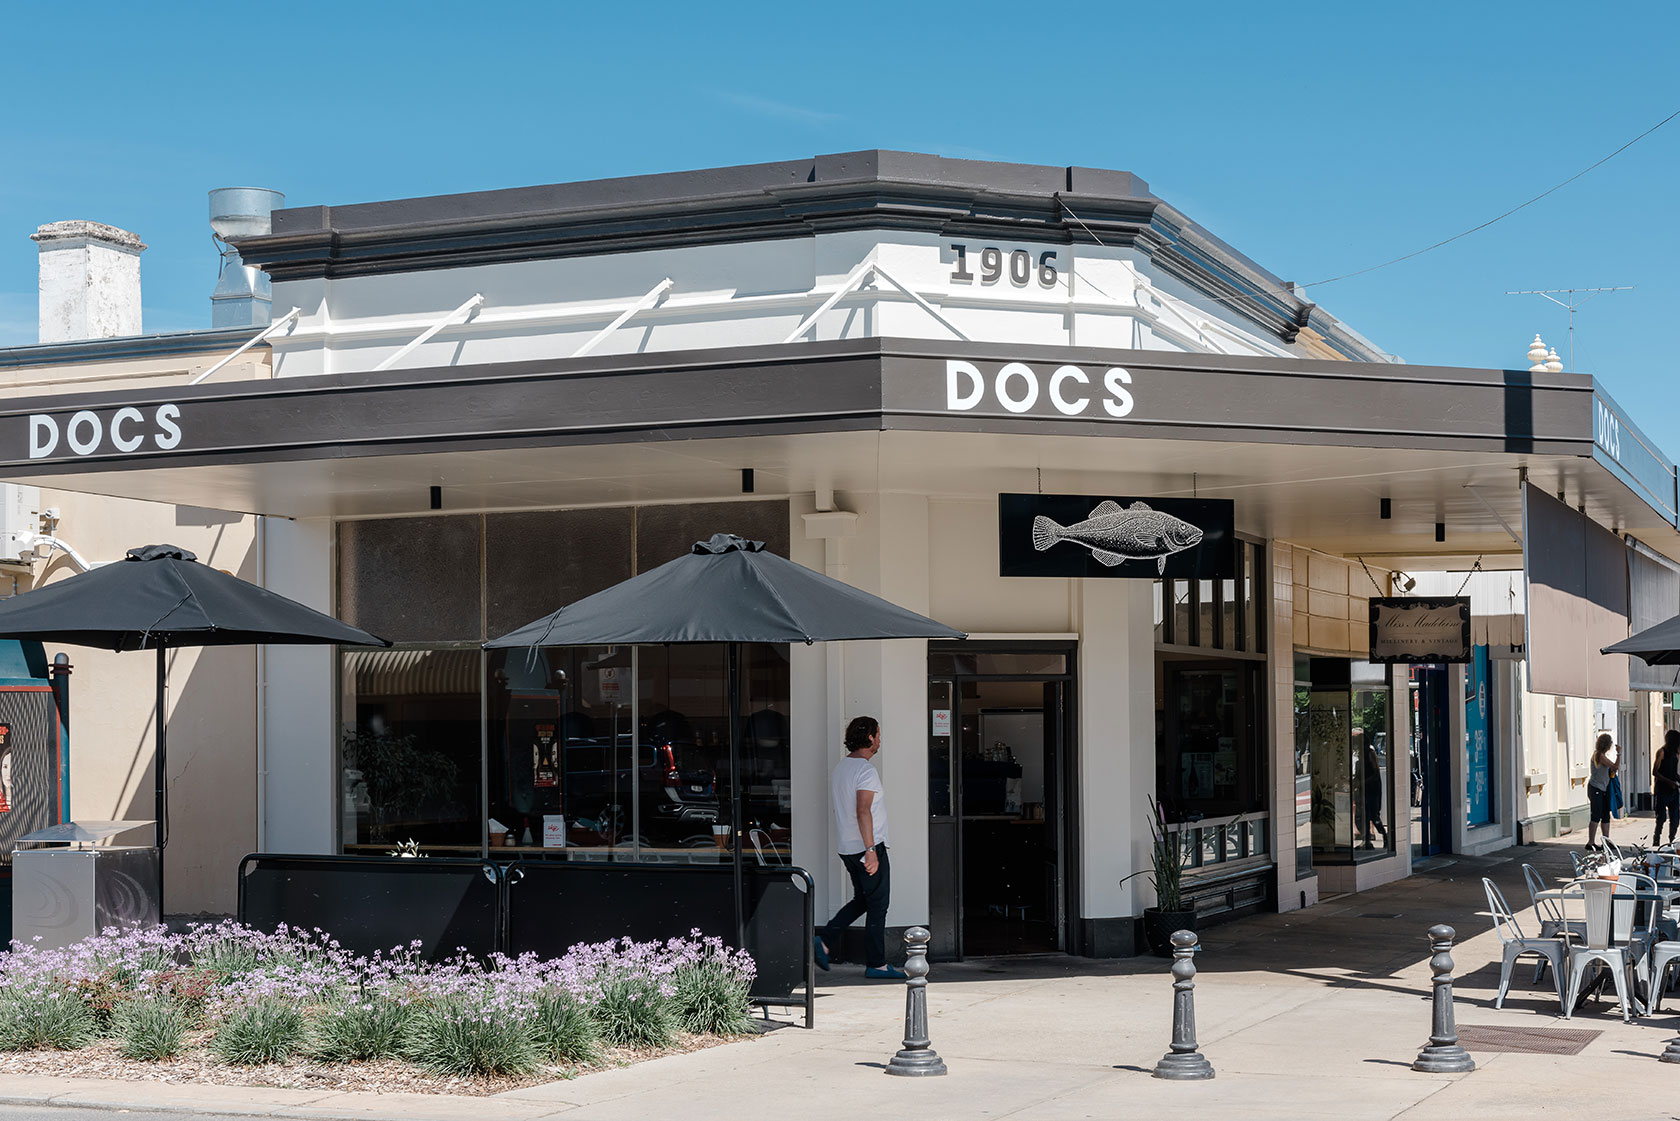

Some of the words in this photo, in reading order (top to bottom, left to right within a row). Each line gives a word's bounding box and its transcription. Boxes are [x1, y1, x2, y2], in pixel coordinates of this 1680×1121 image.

[950, 244, 1058, 286] 1906
[946, 359, 1134, 418] DOCS
[28, 403, 182, 459] DOCS
[1598, 400, 1620, 461] DOCS
[1380, 614, 1404, 628] Miss
